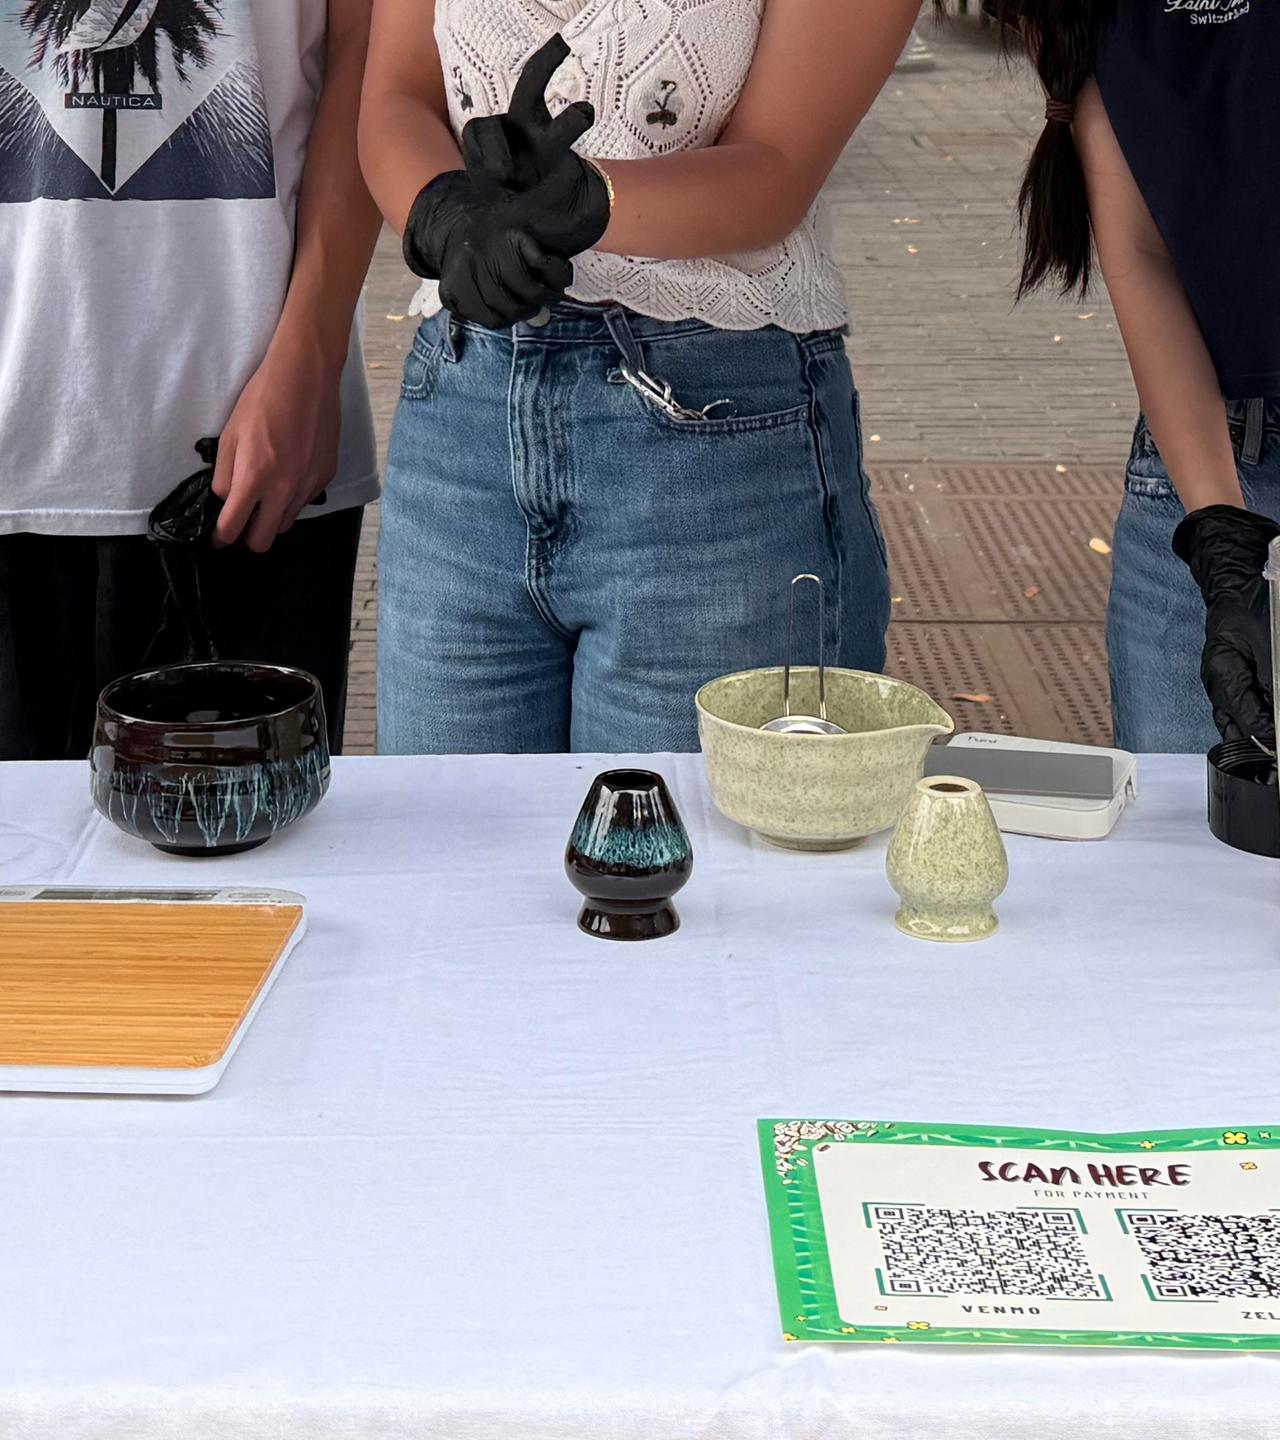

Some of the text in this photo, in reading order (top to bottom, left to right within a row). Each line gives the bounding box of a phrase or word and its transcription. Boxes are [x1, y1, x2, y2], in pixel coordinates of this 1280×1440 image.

[72, 95, 155, 107] NAUTICA
[978, 1161, 1193, 1187] SCAN HERE
[1033, 1189, 1151, 1200] FOR PAYMENT
[961, 1304, 1041, 1315] VENMO
